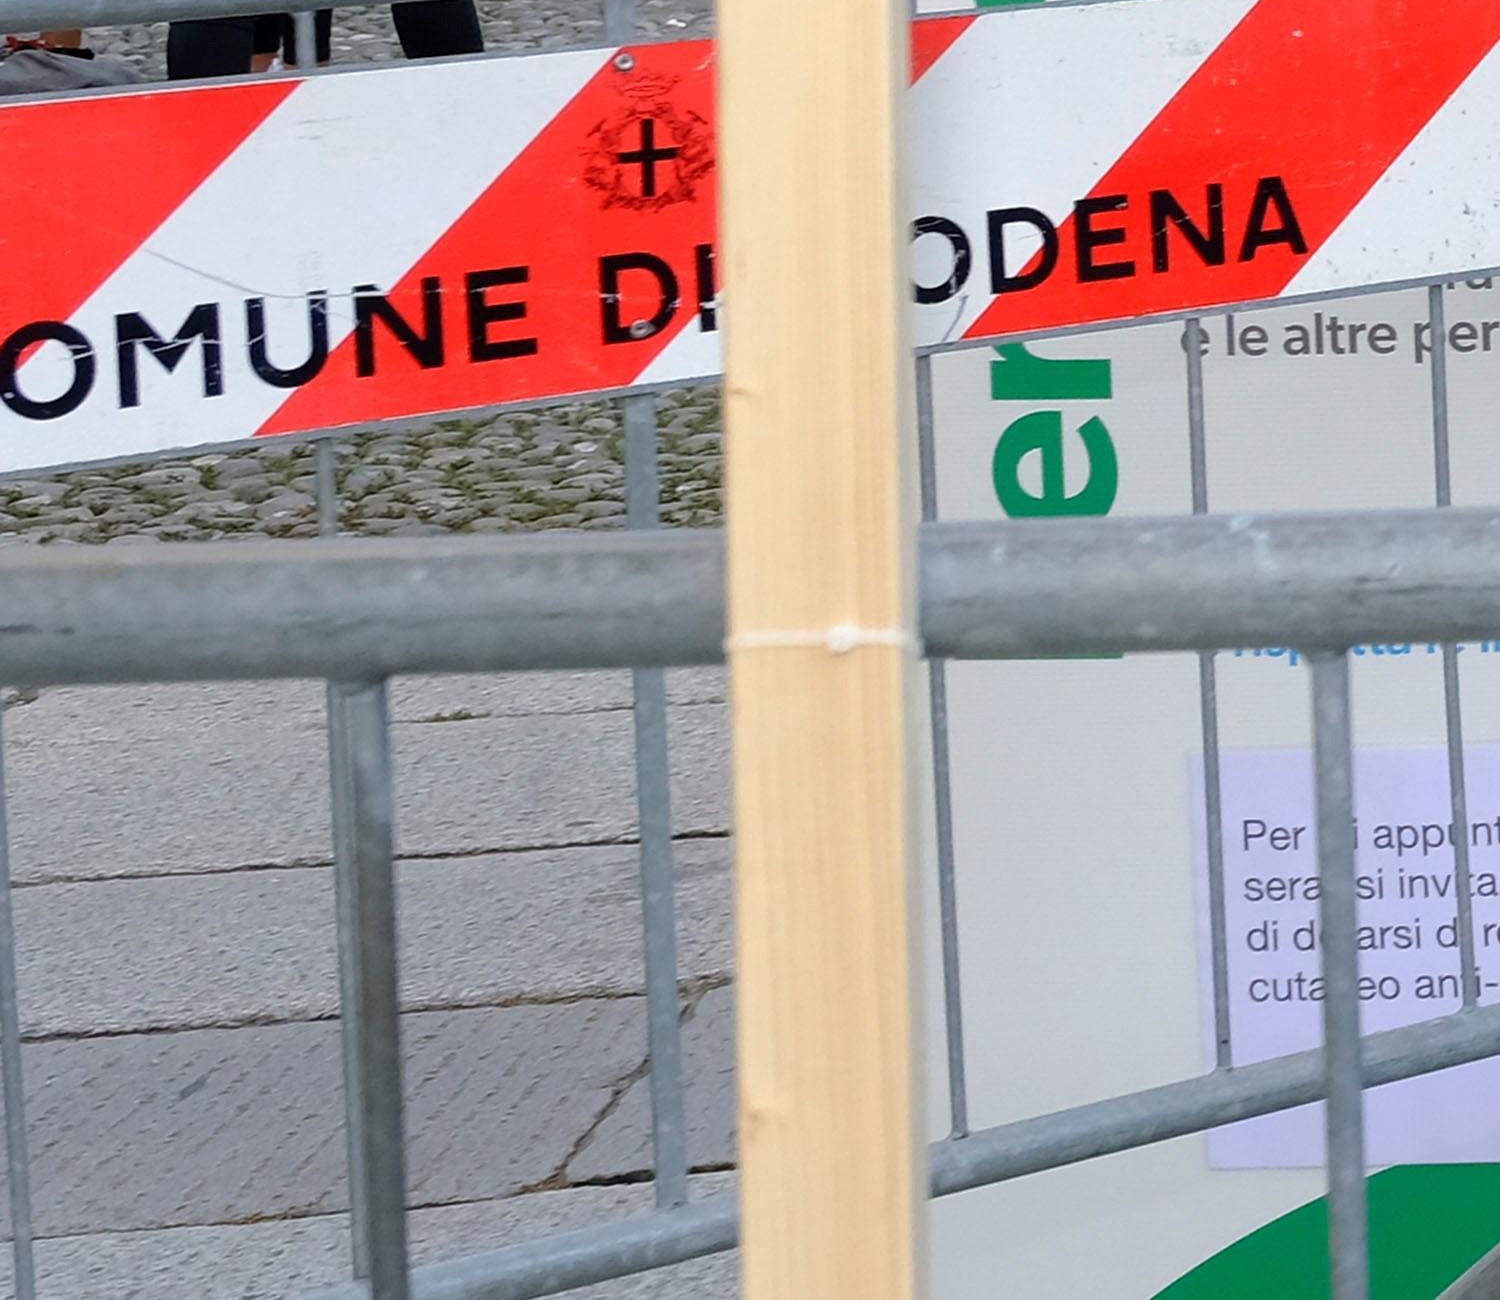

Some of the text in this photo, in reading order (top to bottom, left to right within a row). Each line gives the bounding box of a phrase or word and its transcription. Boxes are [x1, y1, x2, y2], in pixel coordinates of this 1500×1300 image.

[0, 175, 1307, 421] OMUNE DI ODENA
[1226, 314, 1268, 357] le
[1283, 312, 1397, 355] altre
[1243, 819, 1305, 851] Per
[1357, 868, 1384, 900] si
[1246, 921, 1279, 952] di
[1293, 920, 1422, 952] darsi
[1437, 918, 1459, 949] d
[1249, 972, 1400, 1003] cutaeo
